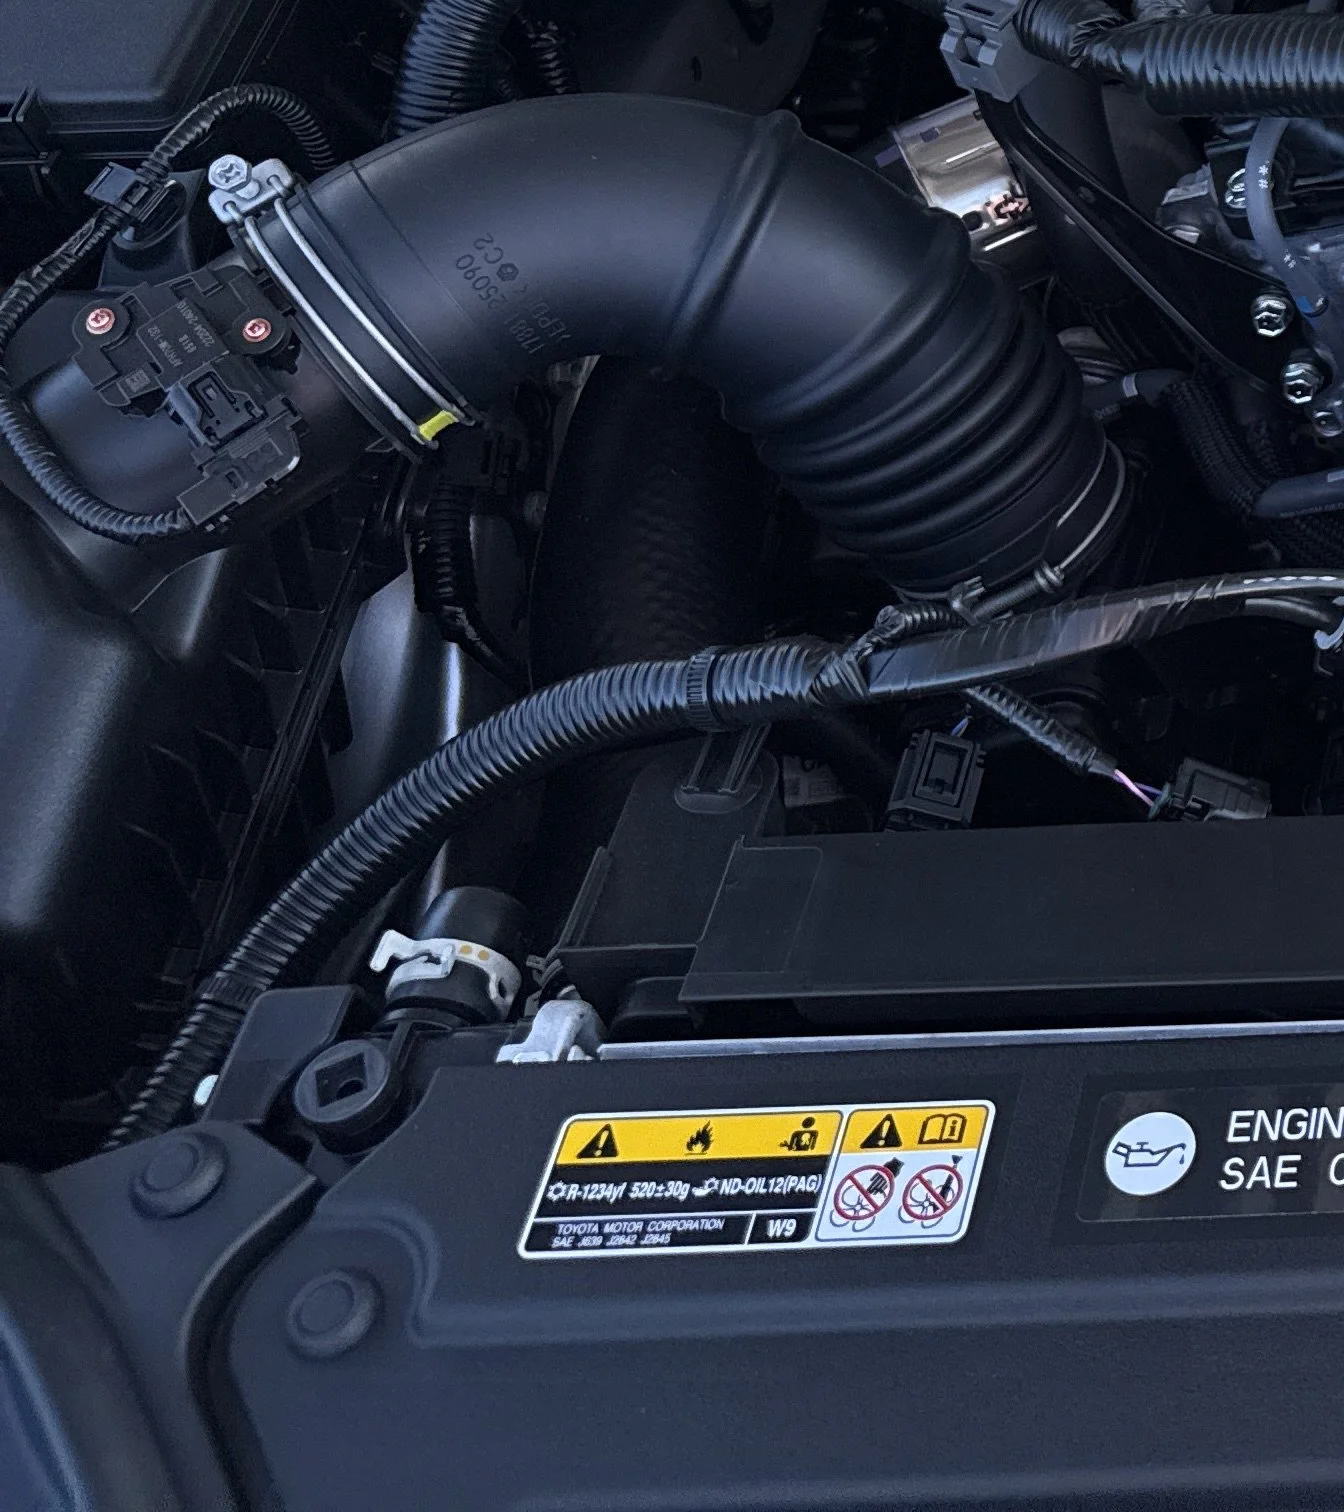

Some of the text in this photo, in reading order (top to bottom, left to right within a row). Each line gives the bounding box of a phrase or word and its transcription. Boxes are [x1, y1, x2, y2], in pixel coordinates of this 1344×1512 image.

[1219, 1154, 1302, 1190] SAE
[567, 1173, 823, 1203] R-1234yf 520±30g ND-OIL12(PAG)
[557, 1218, 725, 1236] TOYOTA MOTOR CORPORATION
[766, 1219, 797, 1238] W9
[551, 1236, 574, 1249] SAE
